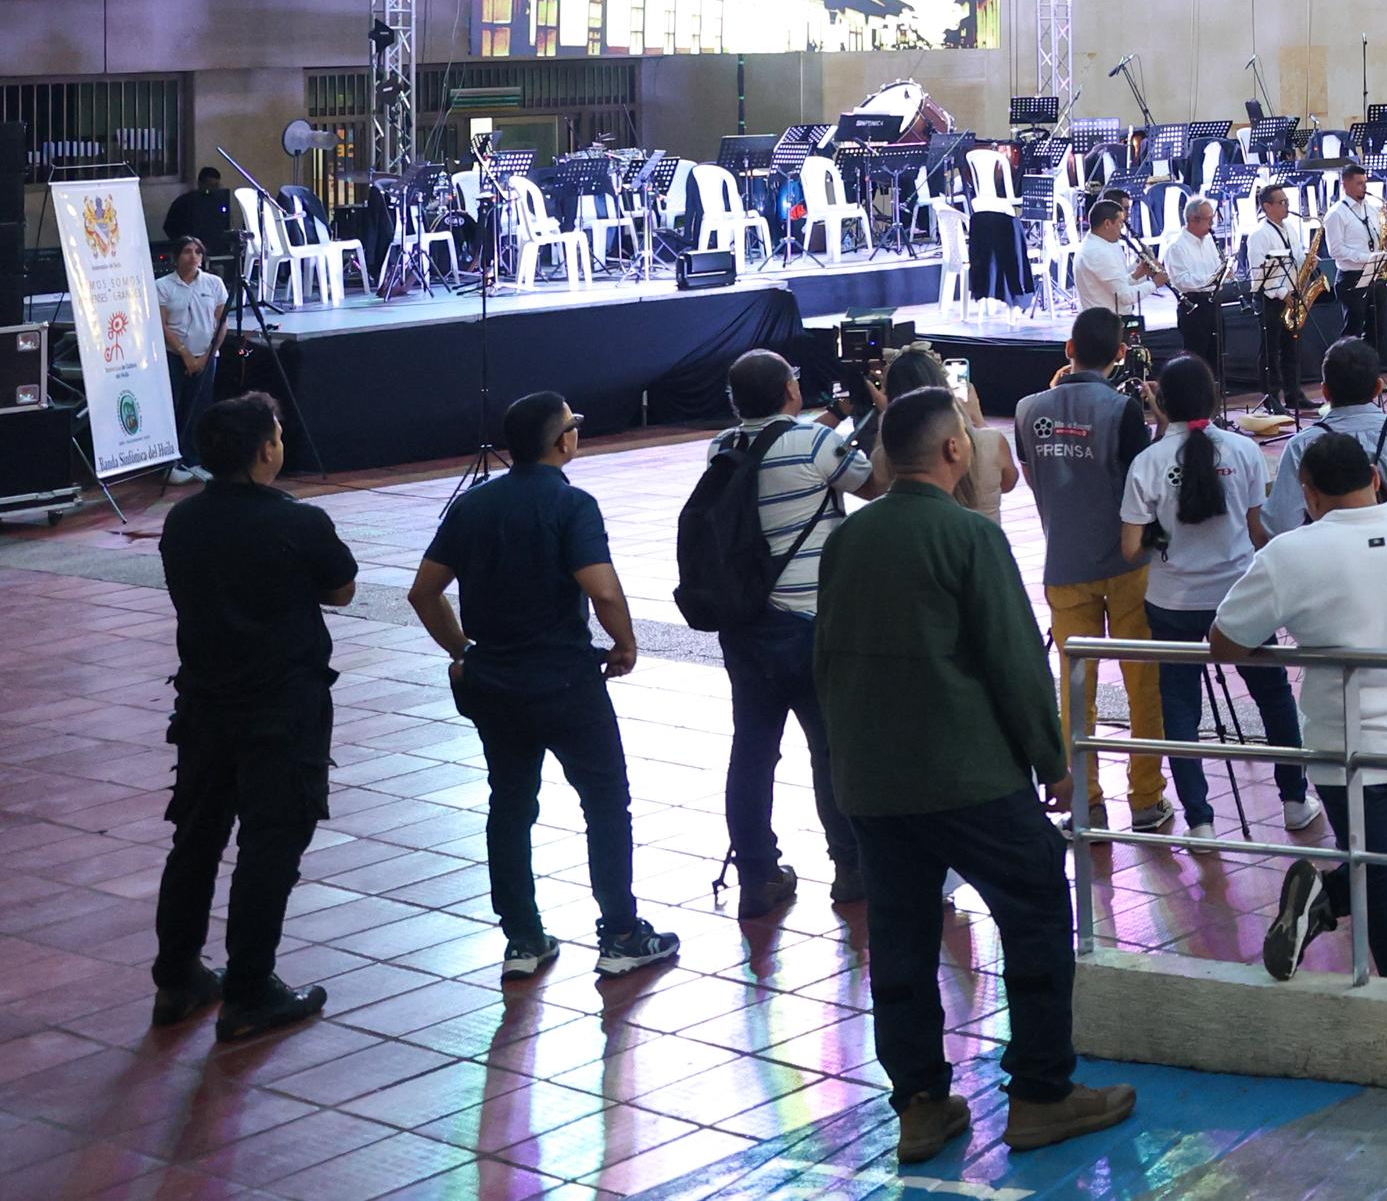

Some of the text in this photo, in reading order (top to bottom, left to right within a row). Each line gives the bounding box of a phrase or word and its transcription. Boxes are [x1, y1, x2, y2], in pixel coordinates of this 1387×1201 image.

[99, 441, 175, 471] Banda Sinfónica del Huila
[1035, 443, 1094, 459] PRENSA
